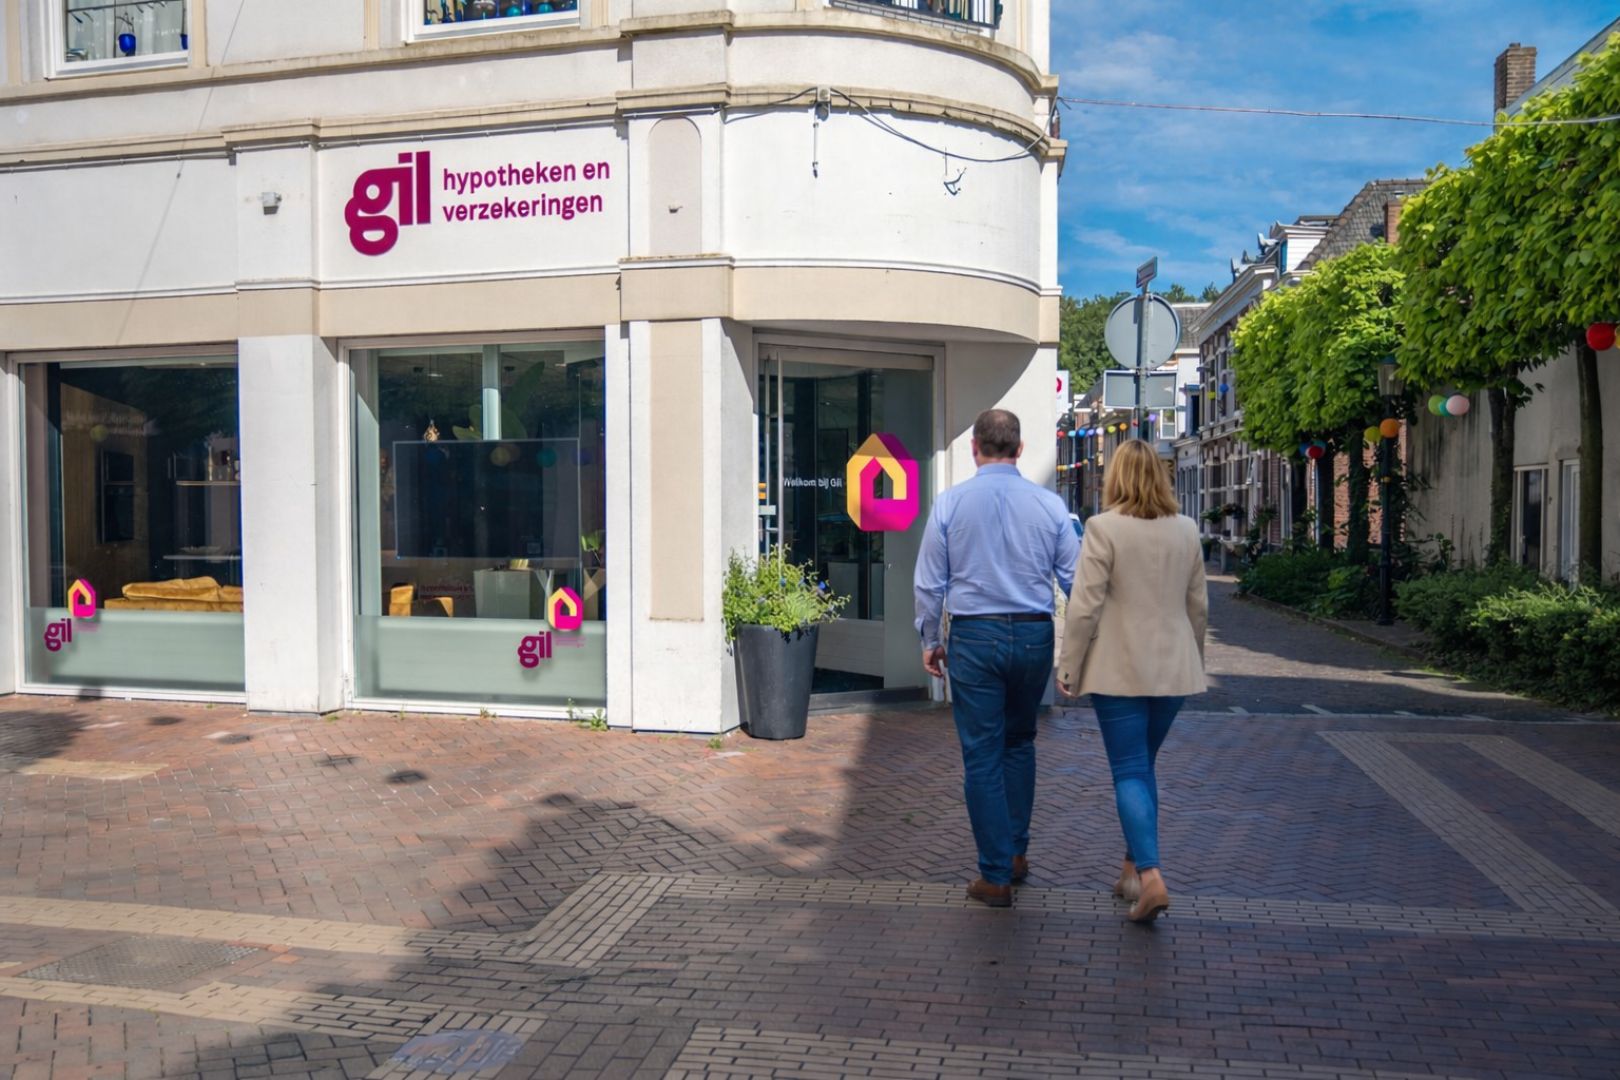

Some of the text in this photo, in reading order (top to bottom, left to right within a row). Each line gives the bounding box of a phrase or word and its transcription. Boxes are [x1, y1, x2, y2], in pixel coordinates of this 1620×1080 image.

[443, 160, 610, 195] hypotheken en
[345, 151, 431, 256] gil
[442, 194, 602, 222] verzekeringen
[44, 618, 72, 651] gil
[518, 631, 552, 669] gil
